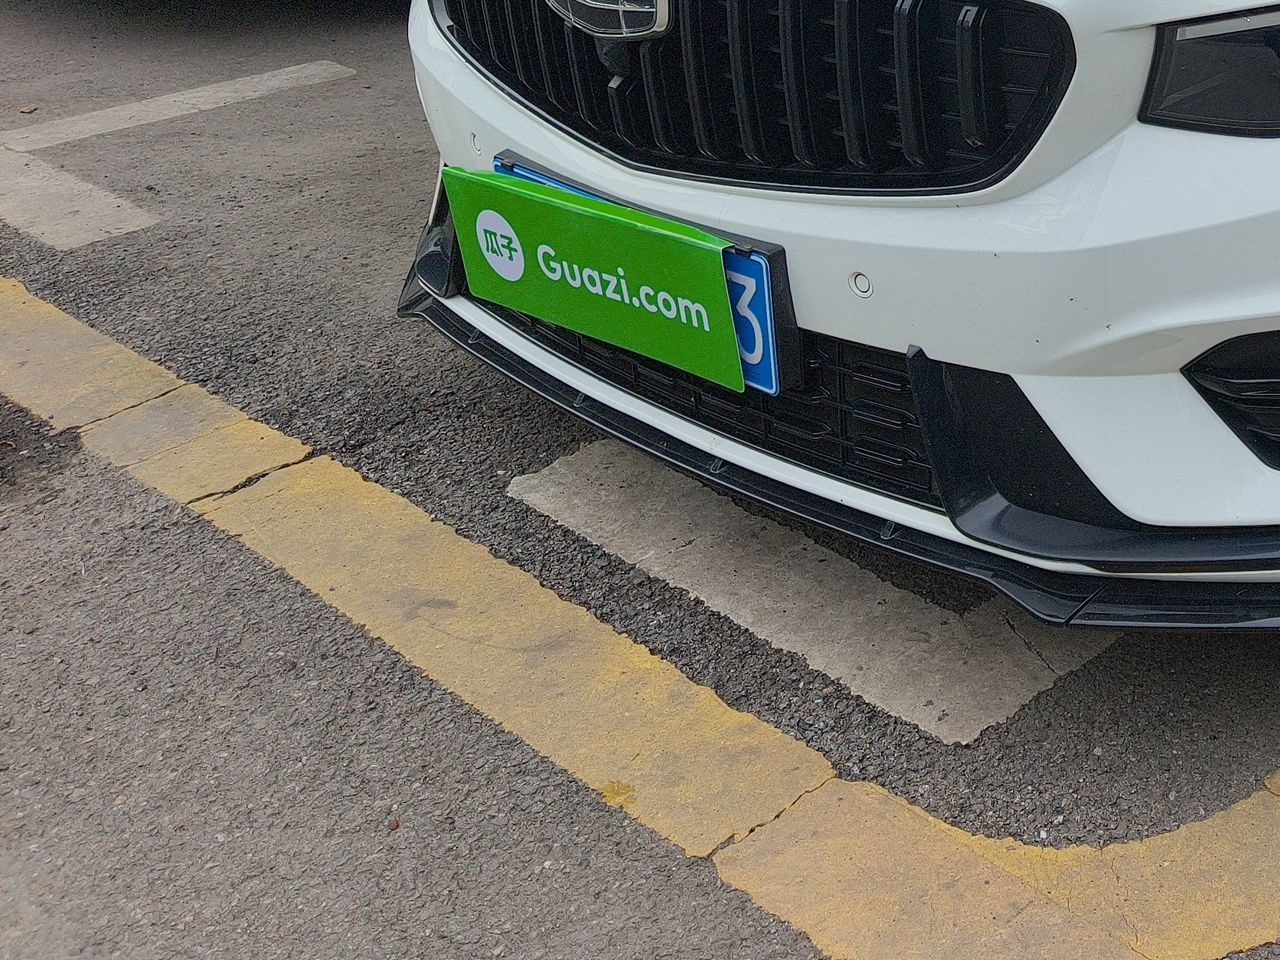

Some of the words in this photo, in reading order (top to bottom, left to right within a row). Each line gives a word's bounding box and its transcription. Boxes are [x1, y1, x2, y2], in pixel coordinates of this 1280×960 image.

[483, 228, 518, 262] 瓜子
[537, 244, 711, 332] Guazi.com
[726, 269, 763, 365] 3
